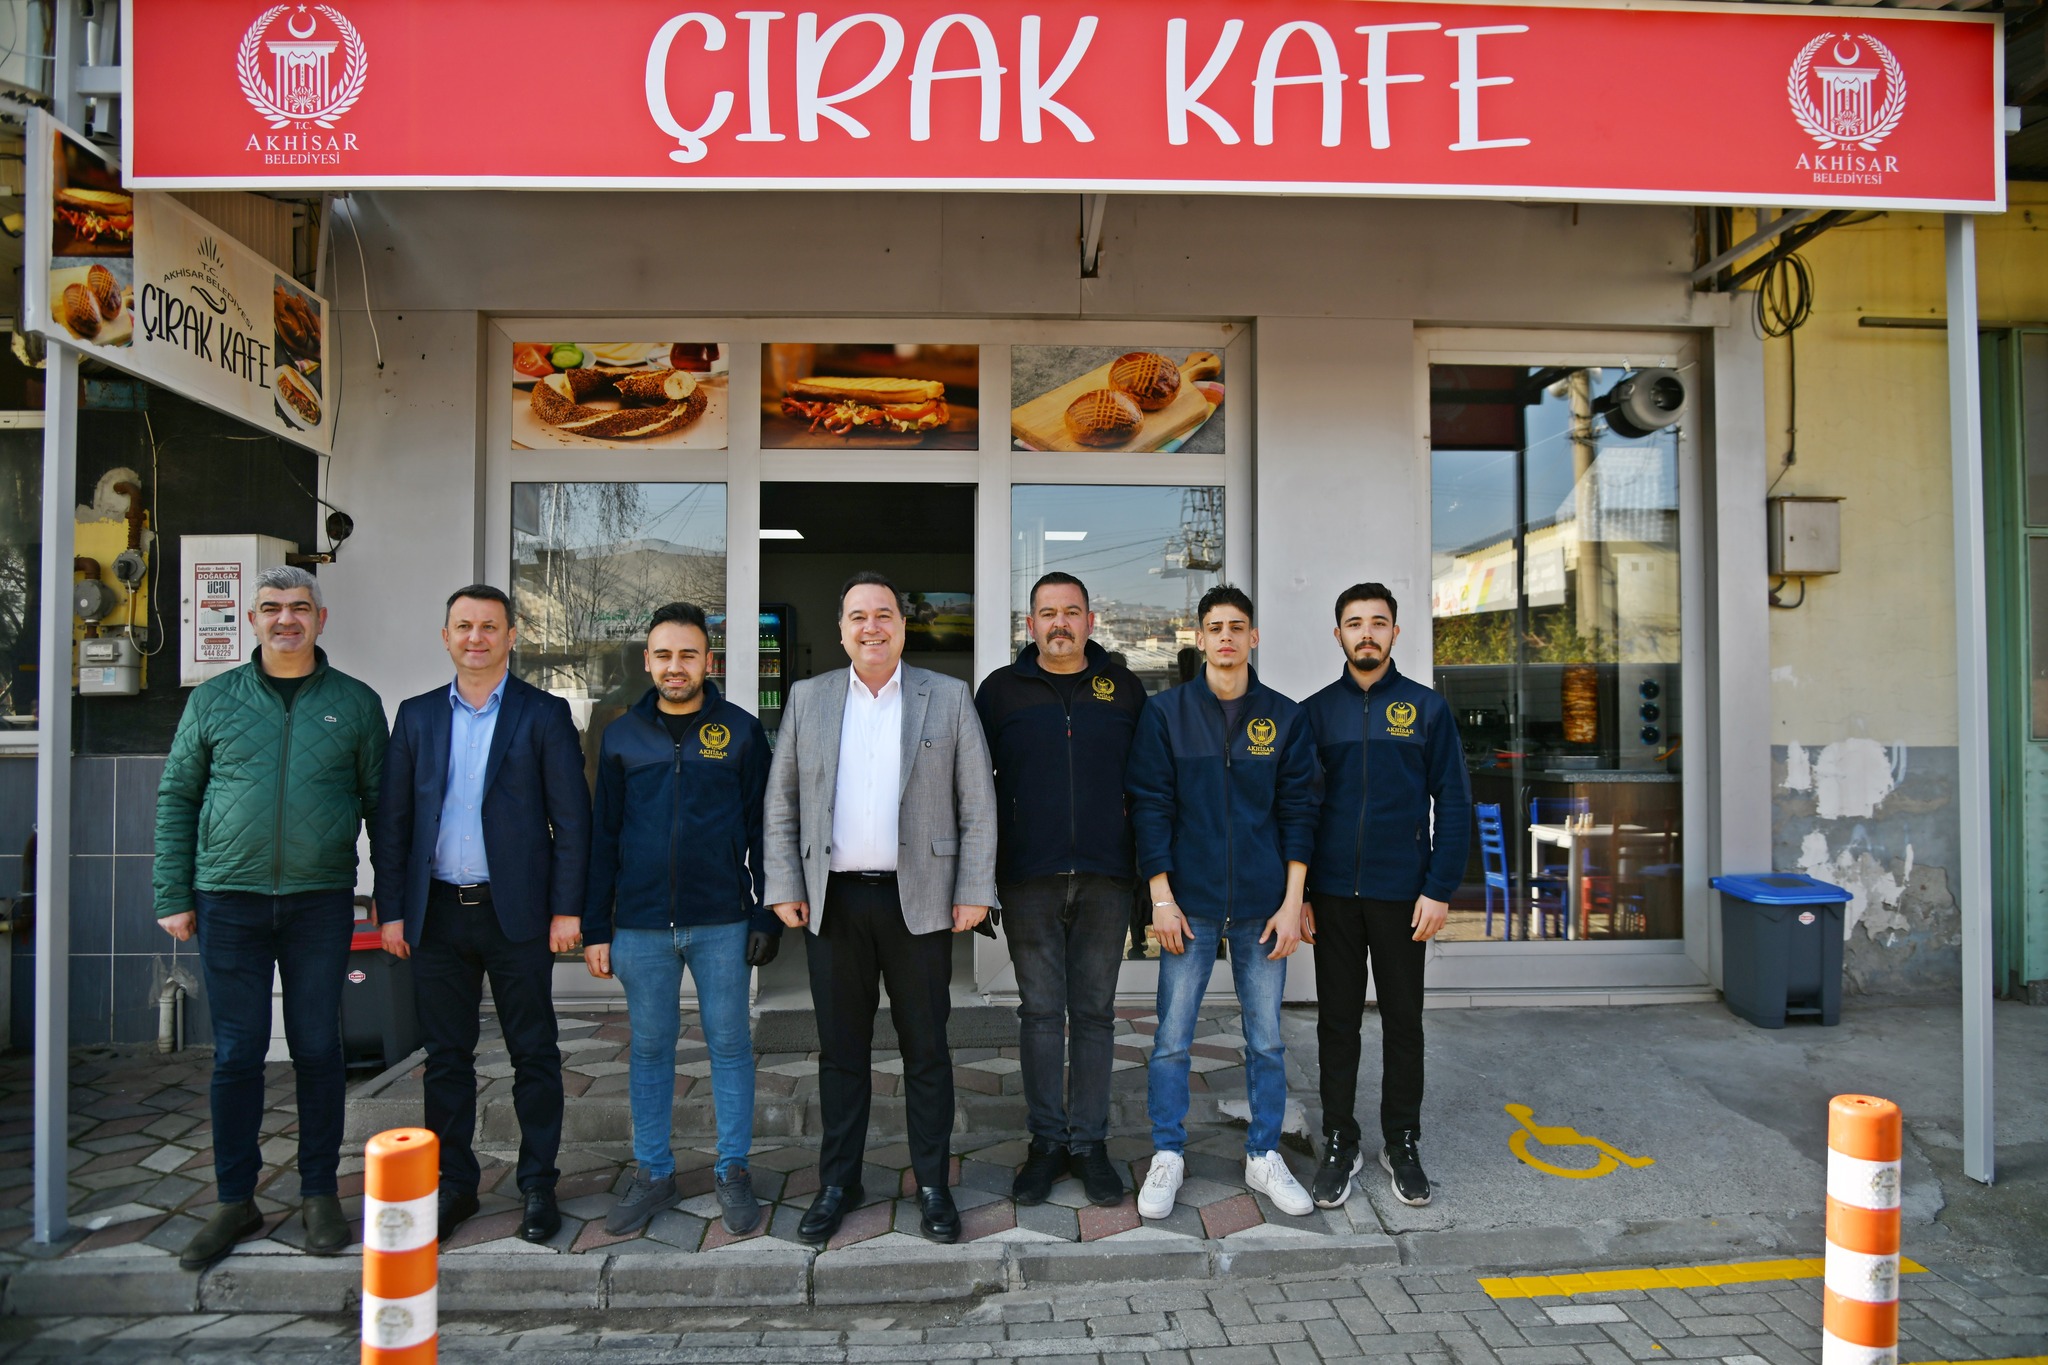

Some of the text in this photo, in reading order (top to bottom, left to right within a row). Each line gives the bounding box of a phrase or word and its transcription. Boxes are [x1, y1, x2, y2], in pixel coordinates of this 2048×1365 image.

[645, 11, 1531, 164] ÇIRAK KAFE
[294, 121, 312, 130] T.C.
[245, 132, 359, 151] AKHİSAR
[1840, 143, 1856, 151] T.C.
[265, 152, 340, 165] BELEDİYESİ
[1794, 153, 1899, 172] AKHİSAR
[1813, 172, 1882, 185] BELEDİYESİ
[164, 268, 205, 283] AKHİSAR
[201, 262, 219, 278] T.C.
[141, 283, 271, 389] ÇIRAK KAFE
[198, 572, 238, 580] DOĞALGAZ
